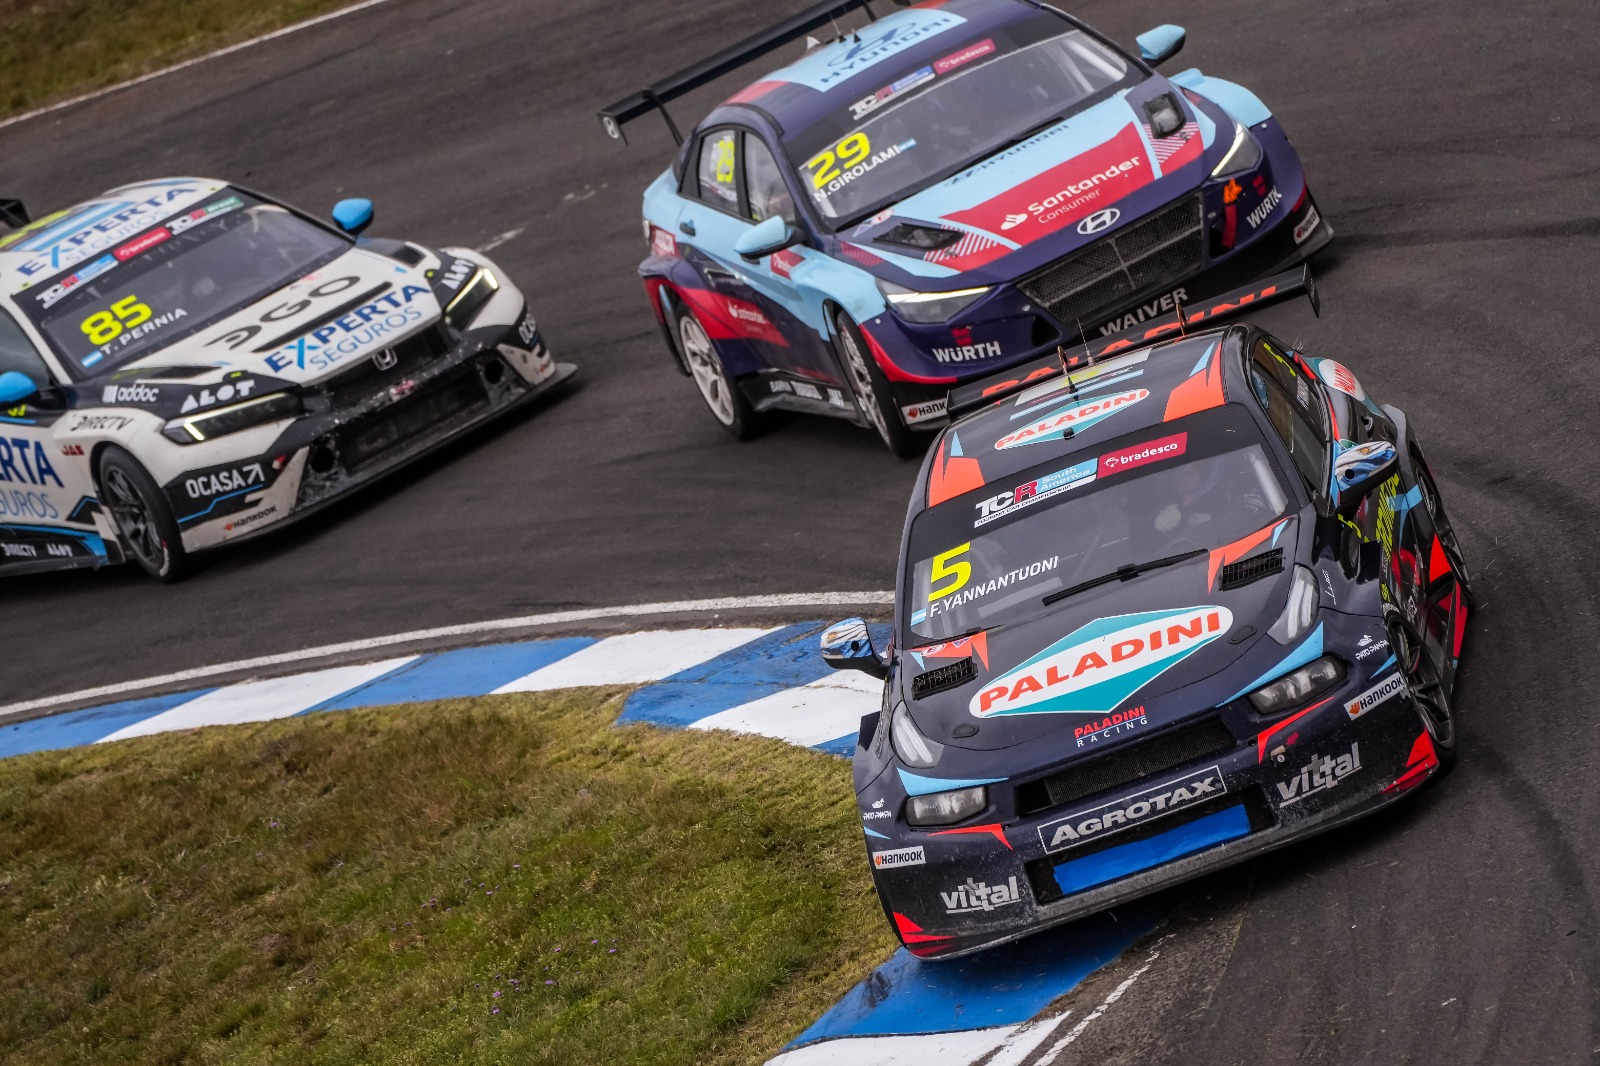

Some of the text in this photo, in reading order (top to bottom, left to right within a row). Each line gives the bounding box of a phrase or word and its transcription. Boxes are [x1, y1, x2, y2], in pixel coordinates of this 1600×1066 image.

[820, 17, 951, 83] HYUNDAI
[949, 44, 990, 65] bradesco
[848, 84, 894, 115] TCR
[808, 132, 871, 190] 29
[1027, 155, 1141, 216] Santander
[1037, 188, 1102, 224] Consumer
[17, 188, 197, 276] EXPERTA
[65, 210, 170, 262] SEGUROS
[80, 295, 152, 345] 85
[264, 284, 432, 373] EXPERTA
[1099, 287, 1190, 337] WAIVER
[310, 306, 422, 370] SEGUROS
[932, 340, 1001, 363] WÜRTH
[117, 384, 160, 403] addoc
[181, 380, 255, 413] ALOT
[996, 389, 1148, 448] PALADINI
[1041, 466, 1077, 484] South
[1120, 442, 1178, 465] bradesco
[186, 469, 245, 498] OCASA
[975, 480, 1039, 518] TCR
[1040, 469, 1091, 492] America
[928, 541, 972, 603] 5
[979, 612, 1220, 712] PALADINI
[1074, 705, 1145, 739] PALADINI
[1077, 717, 1148, 747] RACING
[1277, 742, 1361, 800] vittal
[1050, 776, 1217, 846] AGROTAX
[940, 876, 1020, 911] vittal
